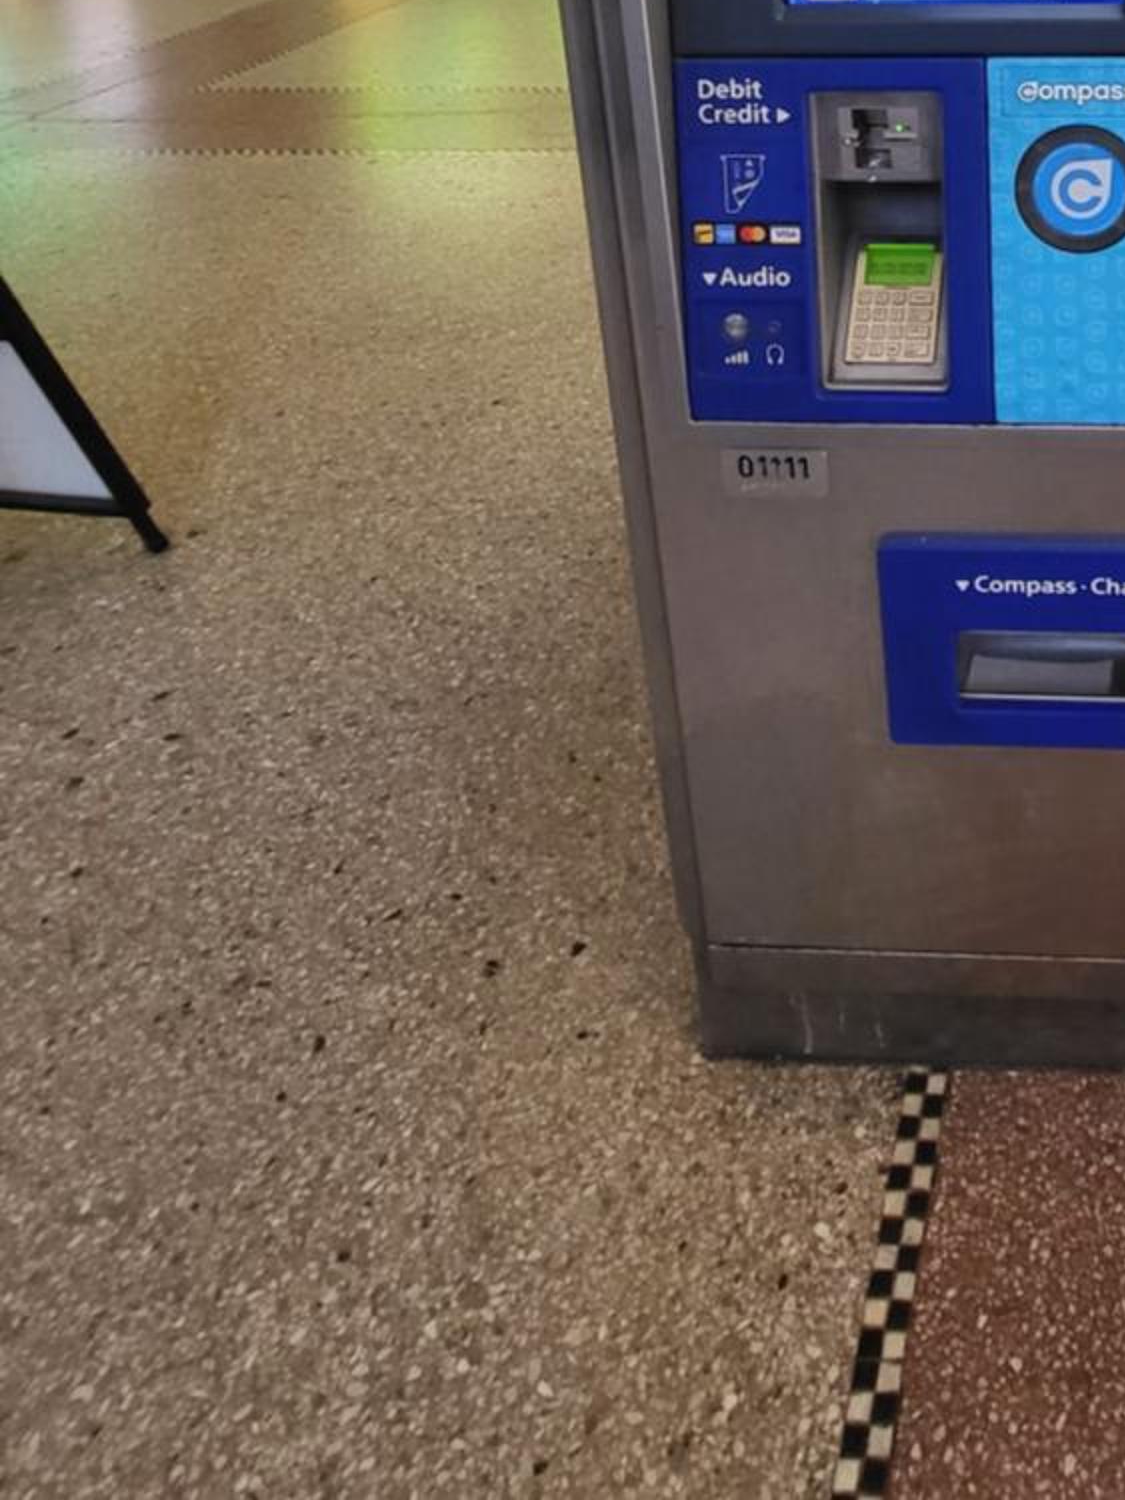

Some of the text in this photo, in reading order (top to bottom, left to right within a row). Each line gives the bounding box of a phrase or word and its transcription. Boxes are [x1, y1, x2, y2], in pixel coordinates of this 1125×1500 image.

[698, 79, 763, 99] Debit
[699, 105, 770, 125] Credit
[719, 269, 791, 287] Audio
[974, 575, 1078, 598] Compass
